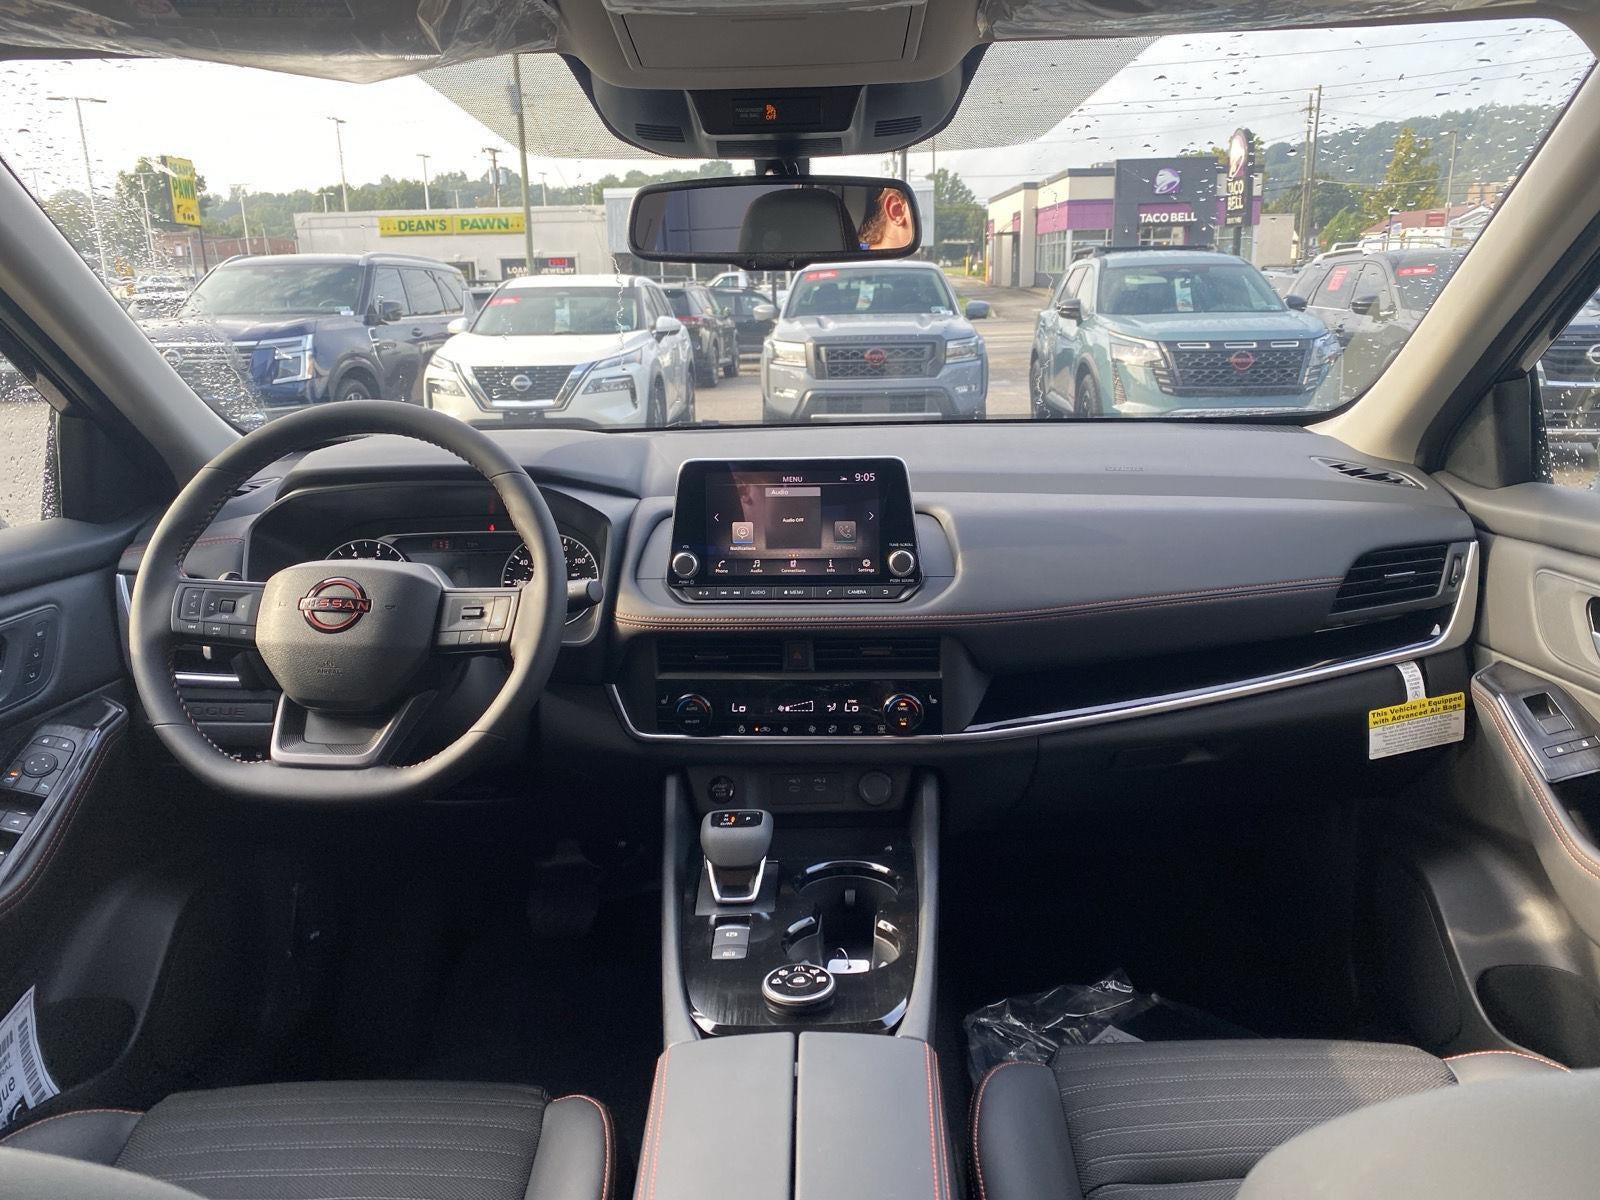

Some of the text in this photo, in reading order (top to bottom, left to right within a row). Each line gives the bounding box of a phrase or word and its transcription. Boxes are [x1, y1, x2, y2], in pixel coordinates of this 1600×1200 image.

[171, 175, 196, 200] PAWN
[1227, 179, 1244, 195] TACO
[1227, 195, 1244, 211] BELL
[397, 218, 510, 232] DEAN'S PAWN
[1139, 212, 1198, 223] TACO BELL
[854, 472, 876, 482] 9:05
[302, 598, 369, 611] NISSAN
[191, 706, 246, 716] OGUE
[1371, 711, 1388, 719] This
[1389, 704, 1418, 714] Vehicle
[1427, 694, 1463, 707] Equipped
[1373, 717, 1389, 726] with
[1391, 710, 1427, 721] Advanced
[1442, 702, 1463, 711] Bags
